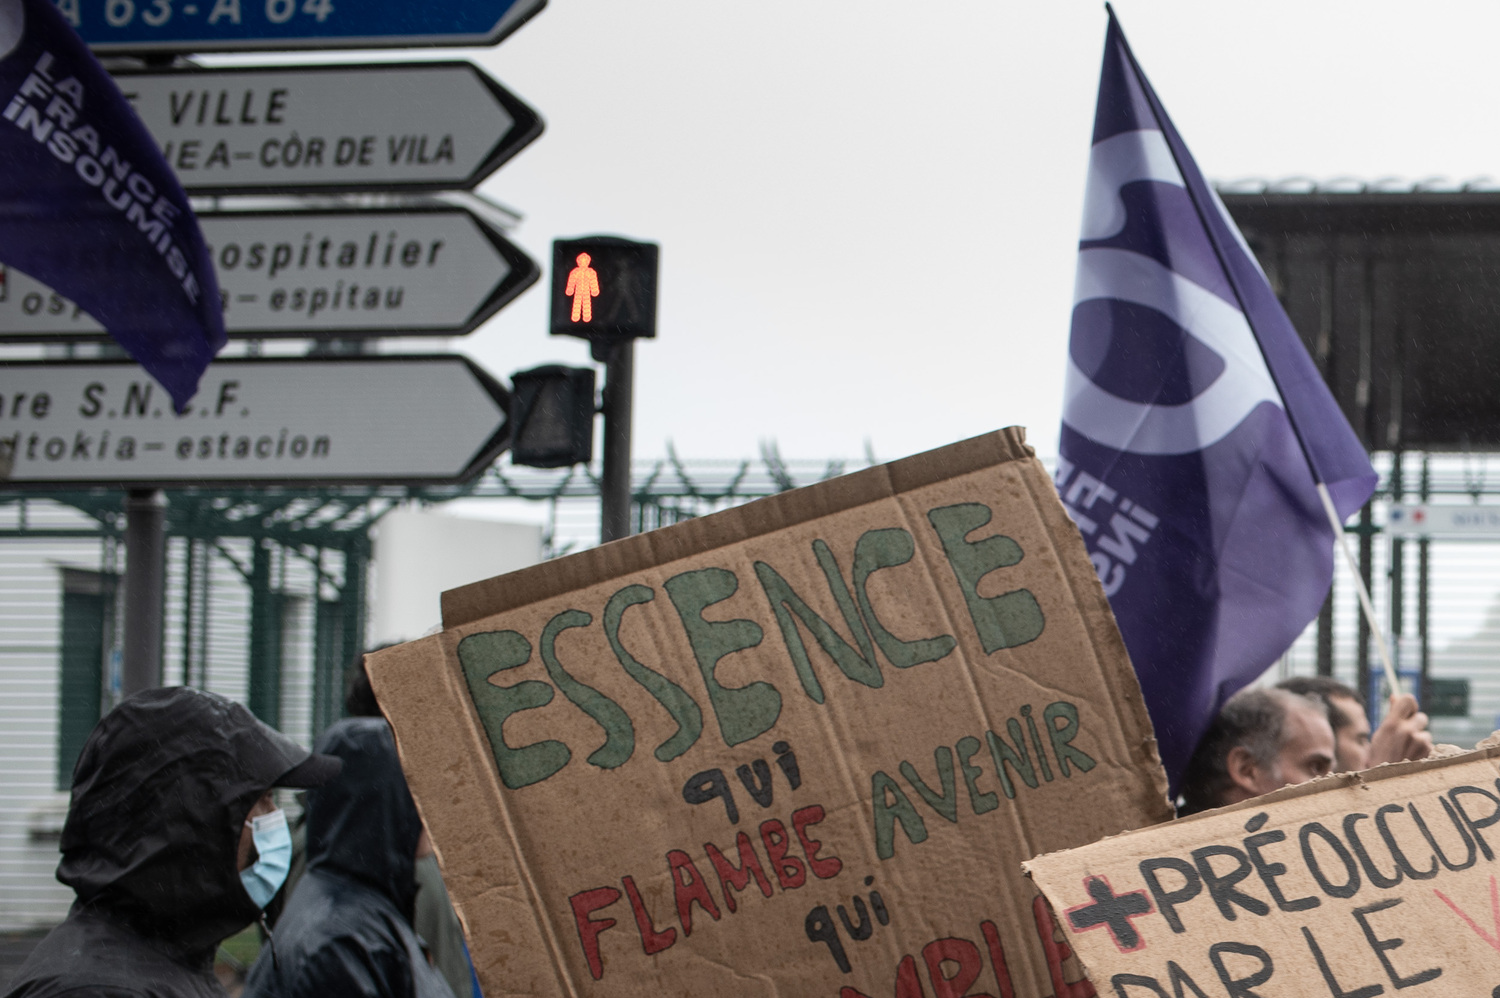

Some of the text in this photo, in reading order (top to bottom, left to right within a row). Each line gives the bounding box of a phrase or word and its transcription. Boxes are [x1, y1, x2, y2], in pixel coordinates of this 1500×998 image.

[34, 51, 85, 110] LA
[168, 88, 289, 127] VILLE
[19, 72, 182, 229] FRANCE
[334, 136, 377, 167] DE
[387, 134, 455, 165] VILA
[209, 230, 445, 279] ospitalier
[457, 502, 1045, 790] ESSENCE
[682, 740, 801, 825] qui
[568, 804, 843, 981] FLAMBE
[805, 875, 890, 974] qui
